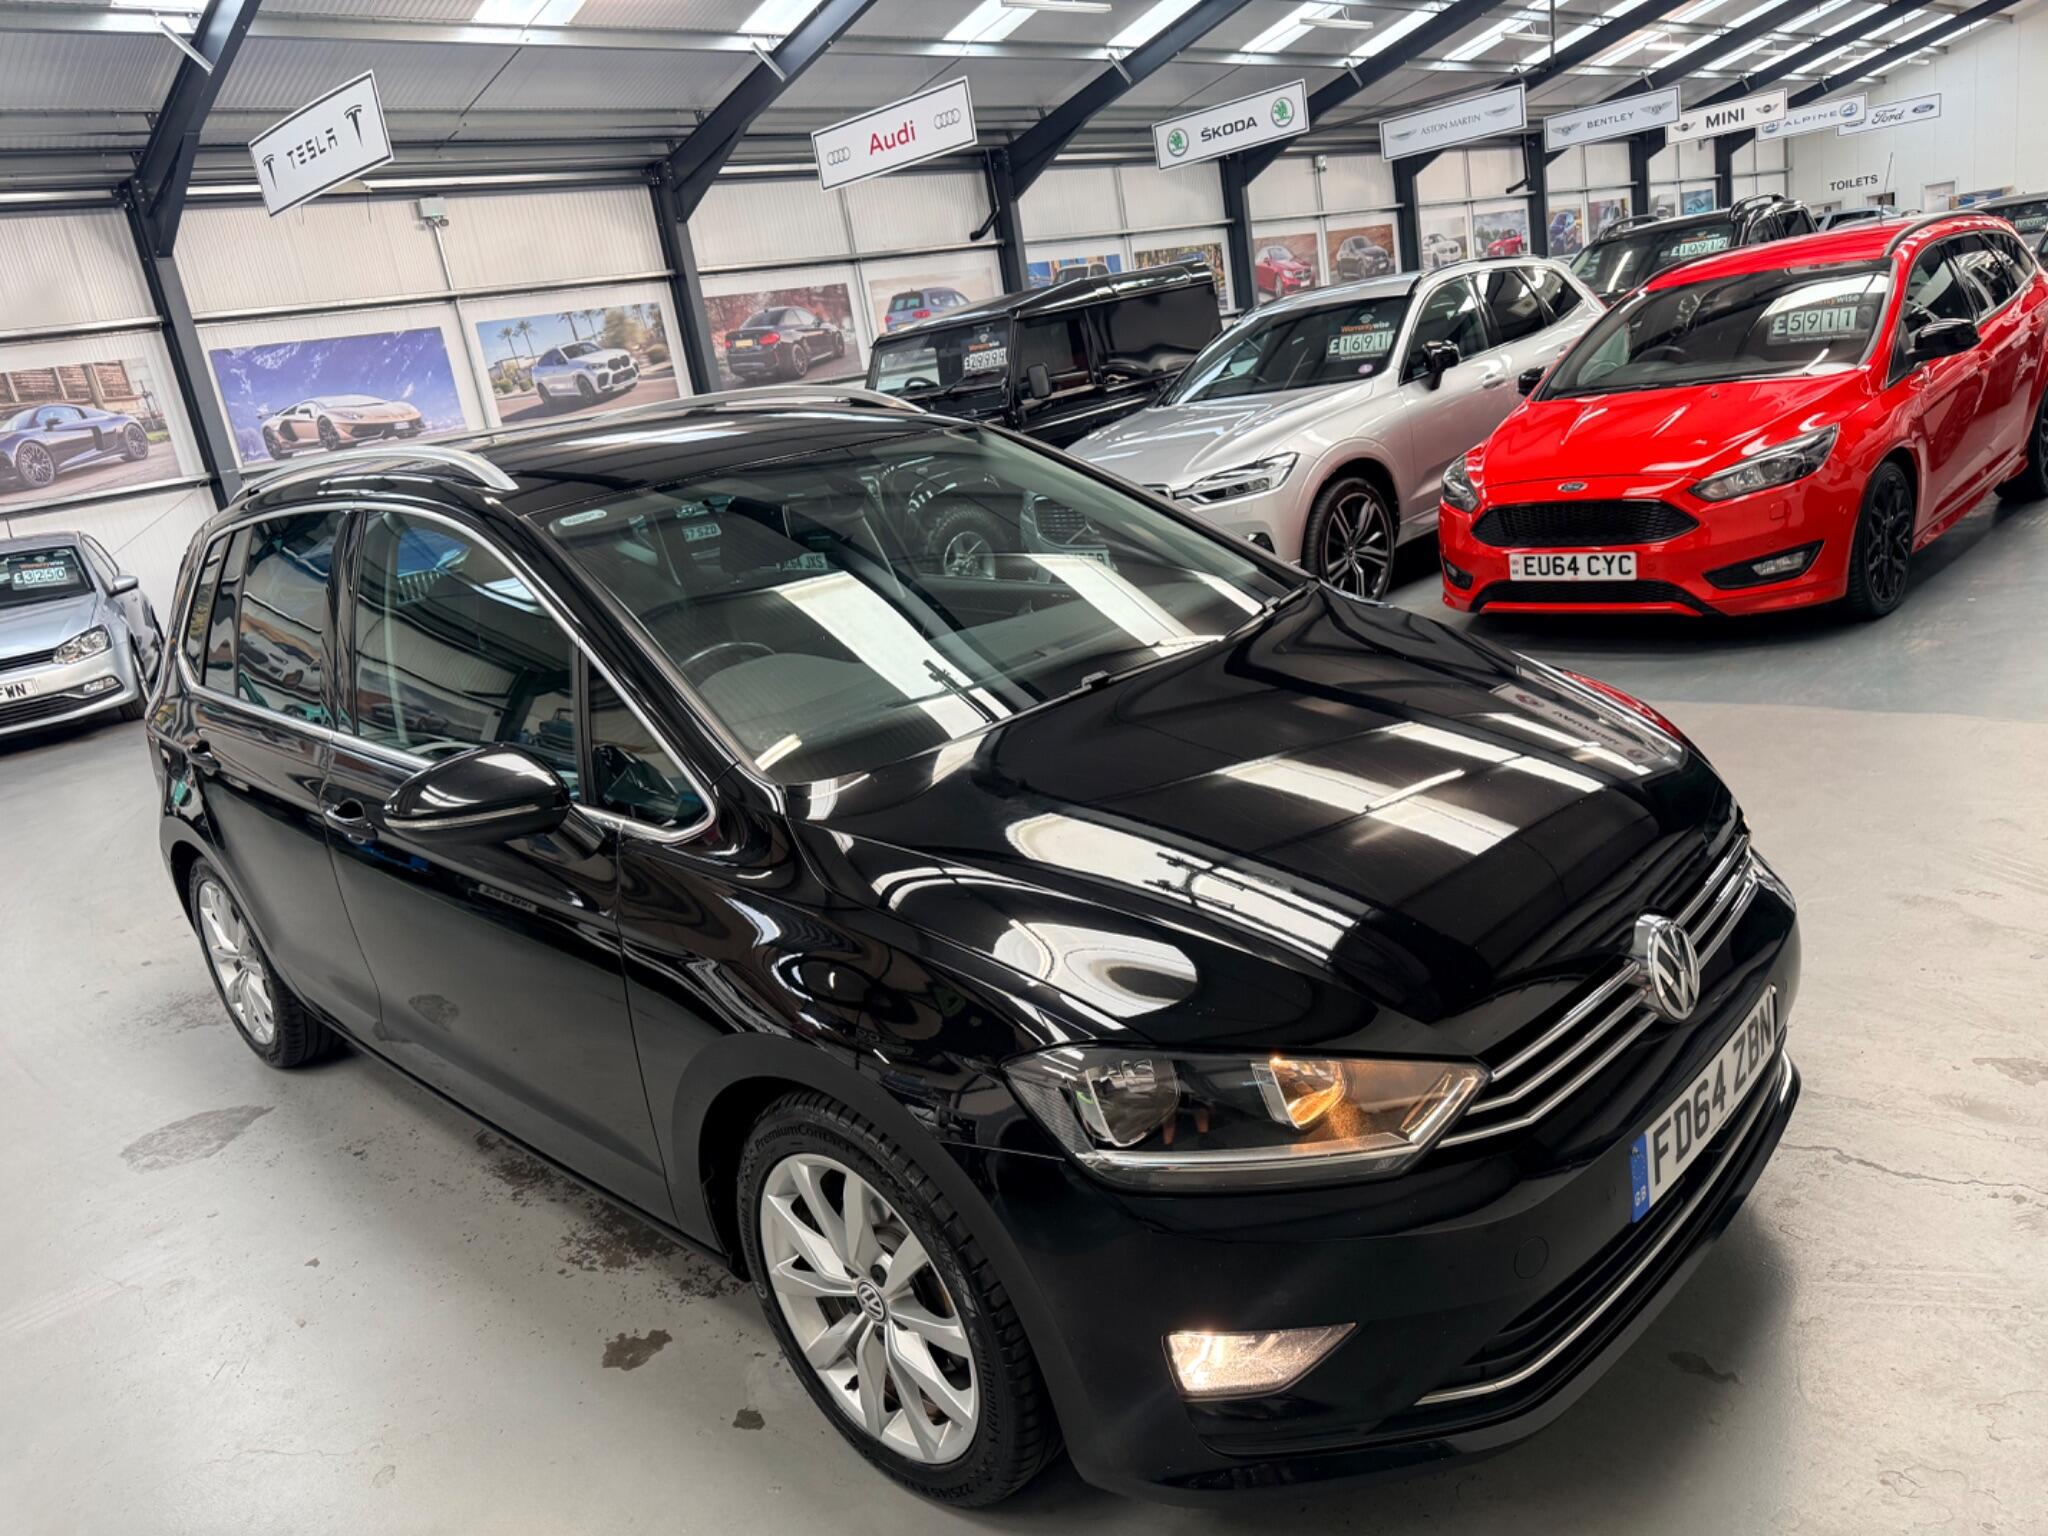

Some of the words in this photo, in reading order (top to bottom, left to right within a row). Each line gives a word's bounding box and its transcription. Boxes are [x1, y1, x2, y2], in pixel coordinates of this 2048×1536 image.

[1420, 121, 1448, 135] ASTON
[1449, 113, 1481, 129] MARTIN
[1587, 111, 1635, 129] BENTLEY
[1705, 107, 1745, 129] MINI
[1783, 110, 1838, 128] ALPINE
[1871, 108, 1905, 125] Ford
[869, 119, 917, 156] Audi
[1200, 116, 1258, 142] ŠKODA
[286, 127, 339, 170] TESLA
[1829, 174, 1879, 191] TOILETS
[1773, 309, 1853, 335] £5911
[1523, 555, 1580, 577] EU64
[1587, 555, 1632, 577] CYC
[1652, 1058, 1727, 1187] FD64
[1733, 995, 1773, 1095] ZBN
[1634, 1185, 1647, 1208] GB
